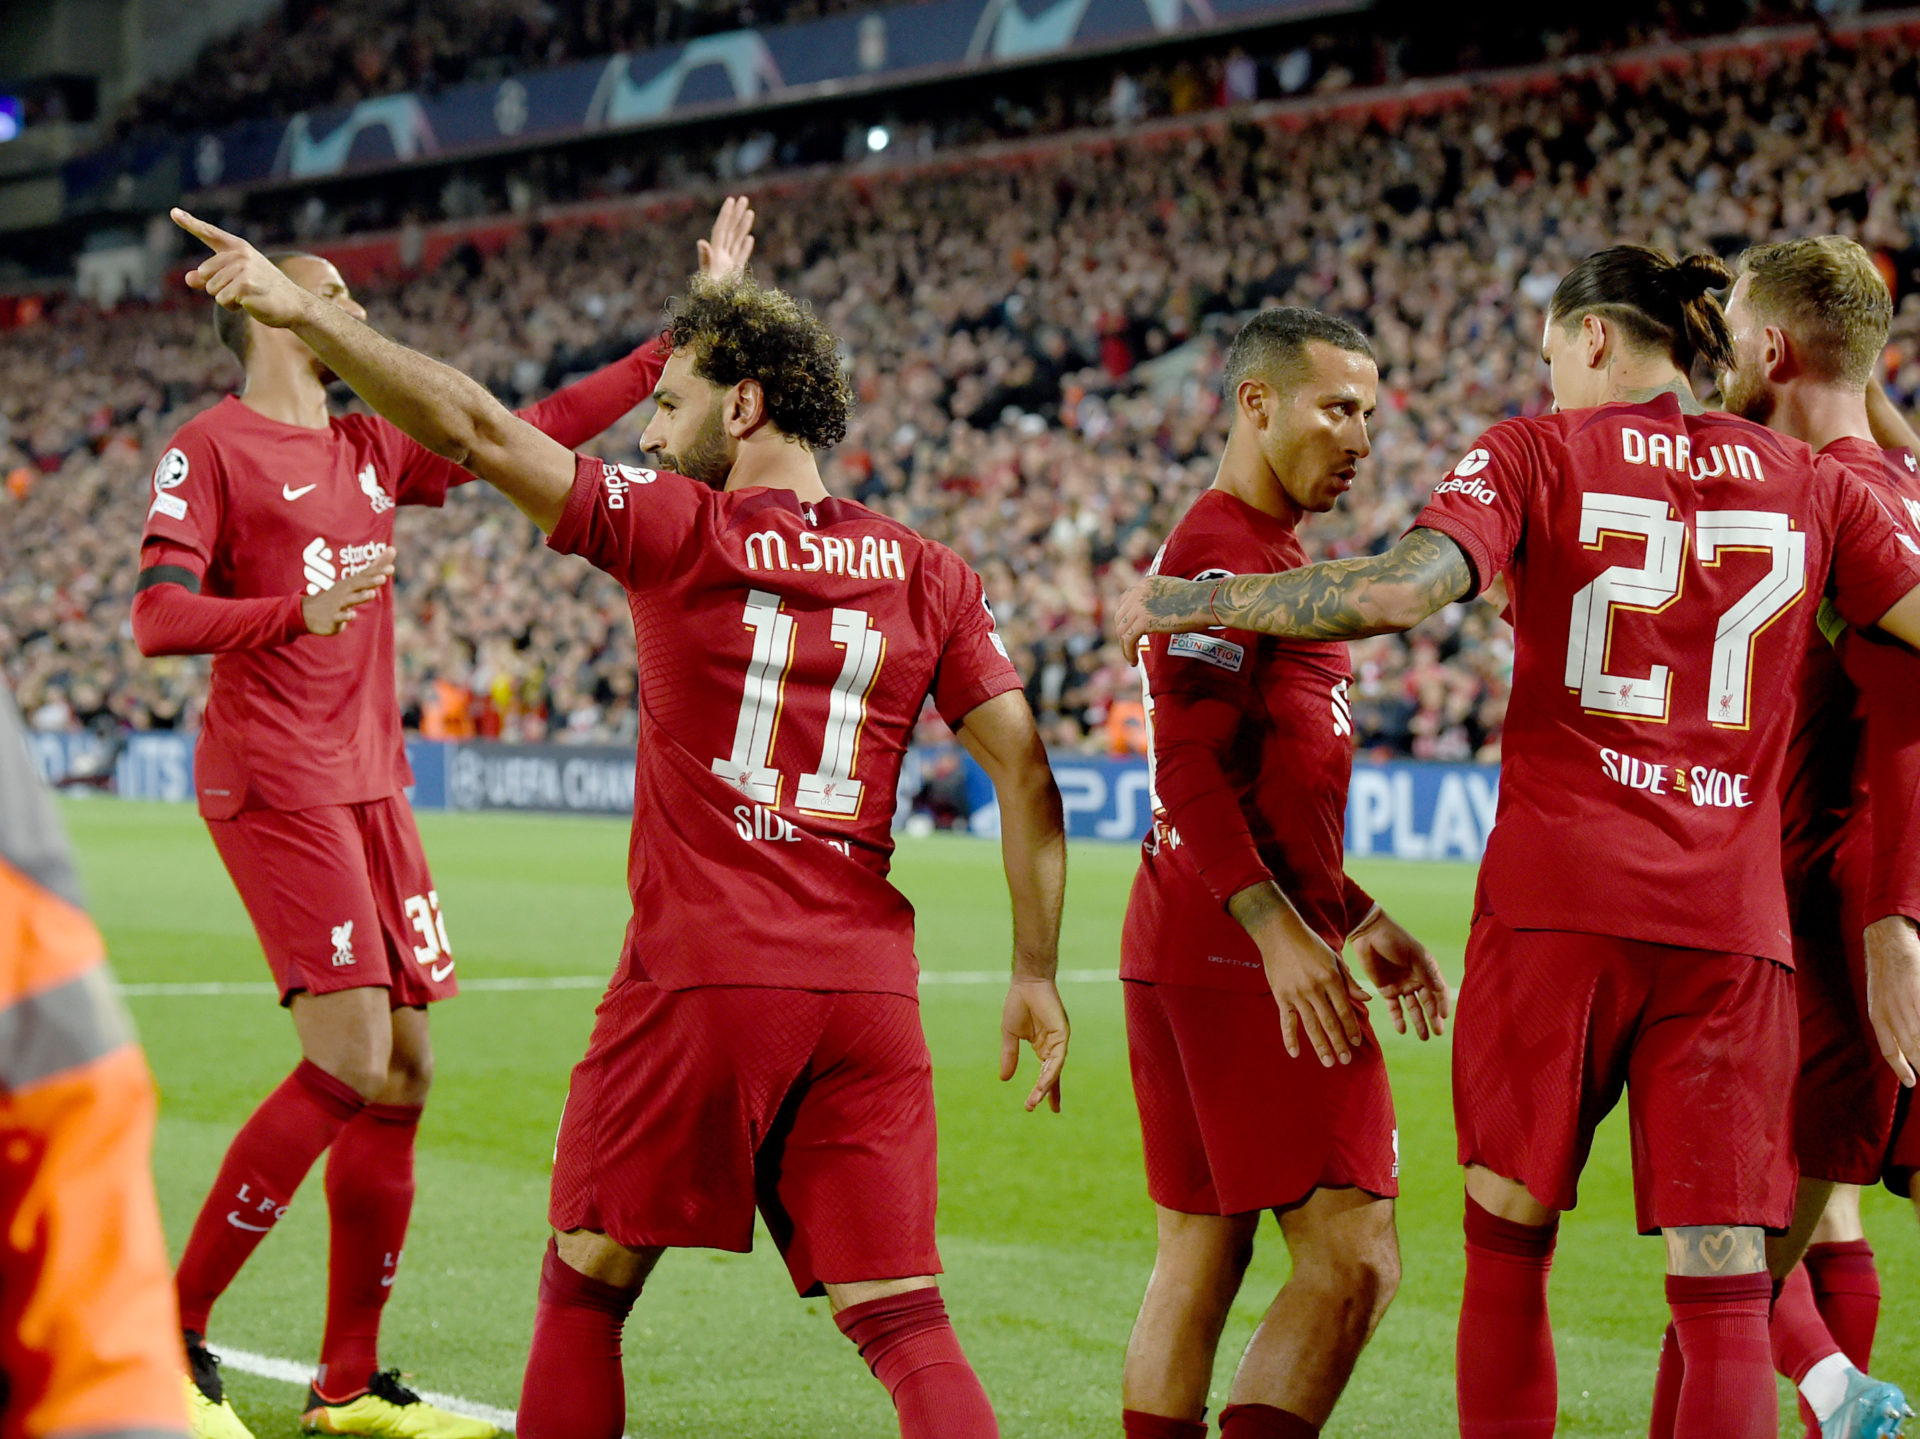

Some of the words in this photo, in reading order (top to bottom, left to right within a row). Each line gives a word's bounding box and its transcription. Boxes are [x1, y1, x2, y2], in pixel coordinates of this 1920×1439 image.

[1621, 427, 1766, 482] DARWIN
[744, 530, 906, 580] M.SALAH
[1564, 491, 1807, 730] 27
[1171, 637, 1242, 664] FOUNDATION
[711, 588, 887, 821] 11
[1600, 747, 1669, 795] SIDE
[1690, 765, 1753, 808] SIDE
[733, 804, 802, 842] SIDE
[1350, 770, 1500, 861] PLAY
